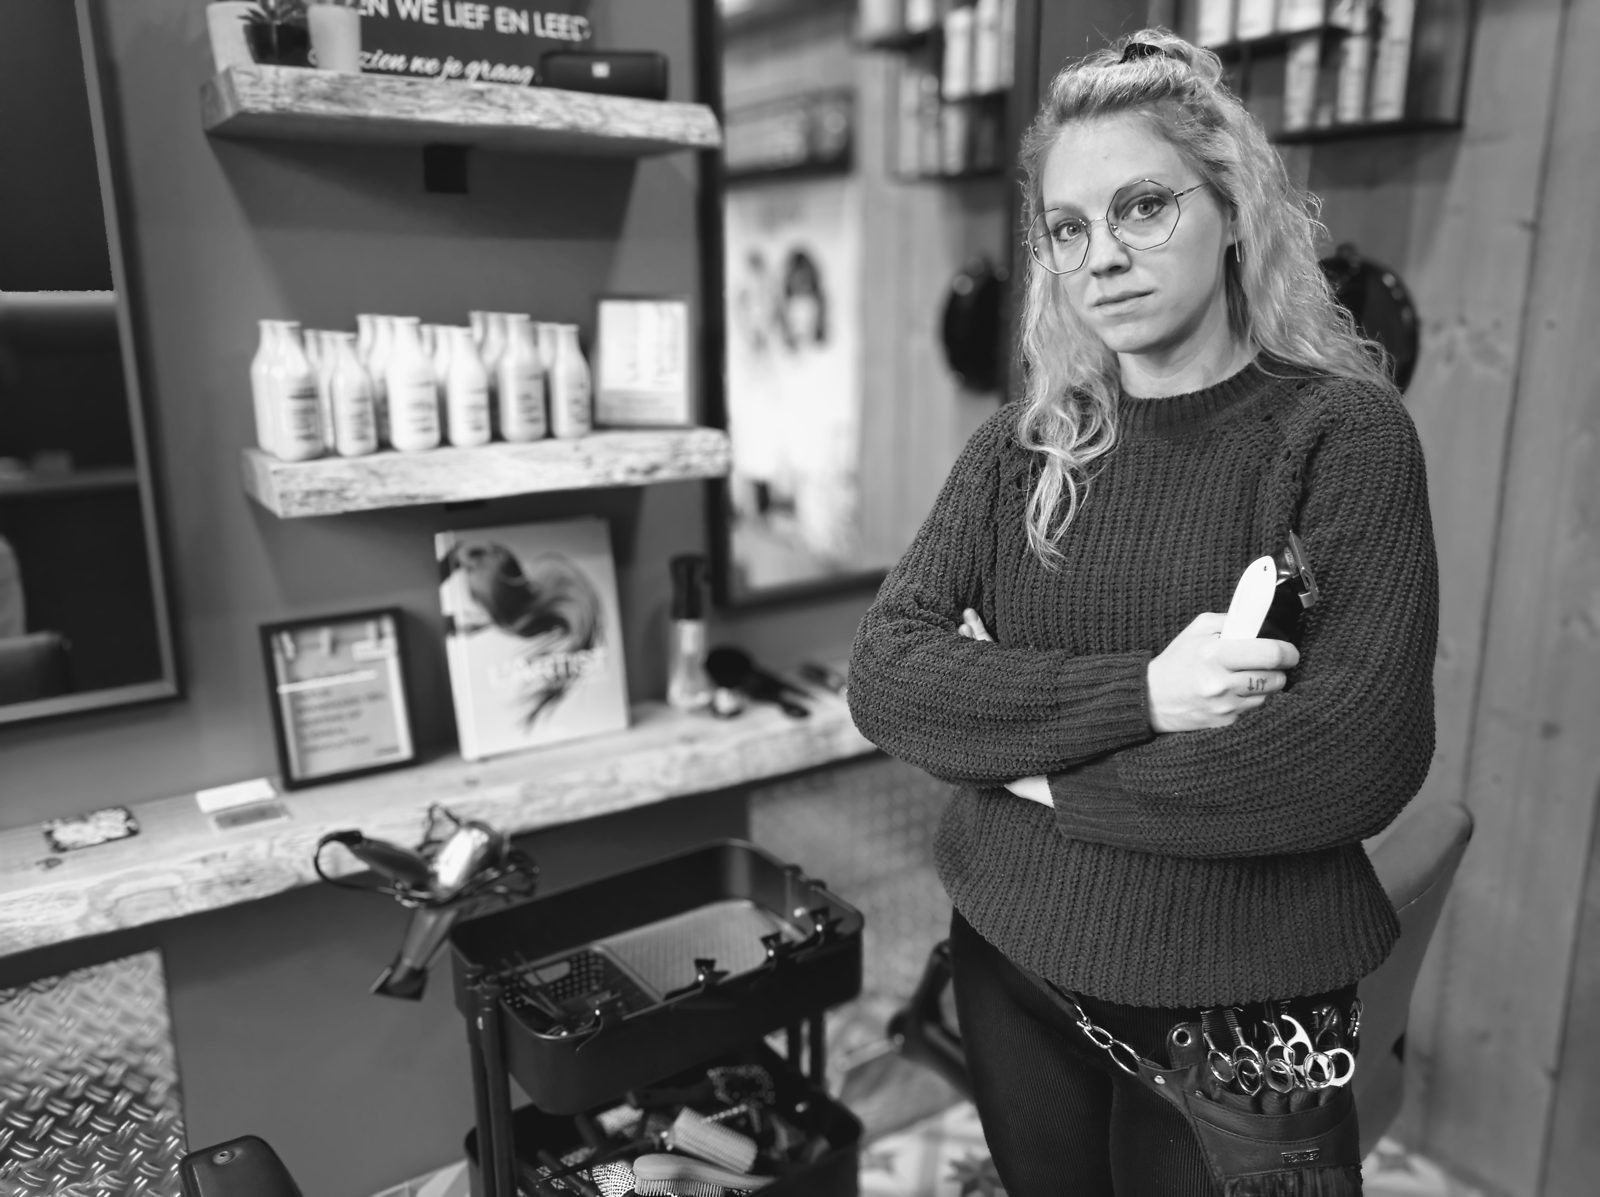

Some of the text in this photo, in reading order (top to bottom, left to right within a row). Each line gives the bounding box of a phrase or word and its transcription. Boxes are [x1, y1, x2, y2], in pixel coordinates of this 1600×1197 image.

[395, 0, 439, 25] WE
[443, 1, 491, 30] LIEF
[494, 6, 530, 35] EN
[433, 55, 464, 83] je
